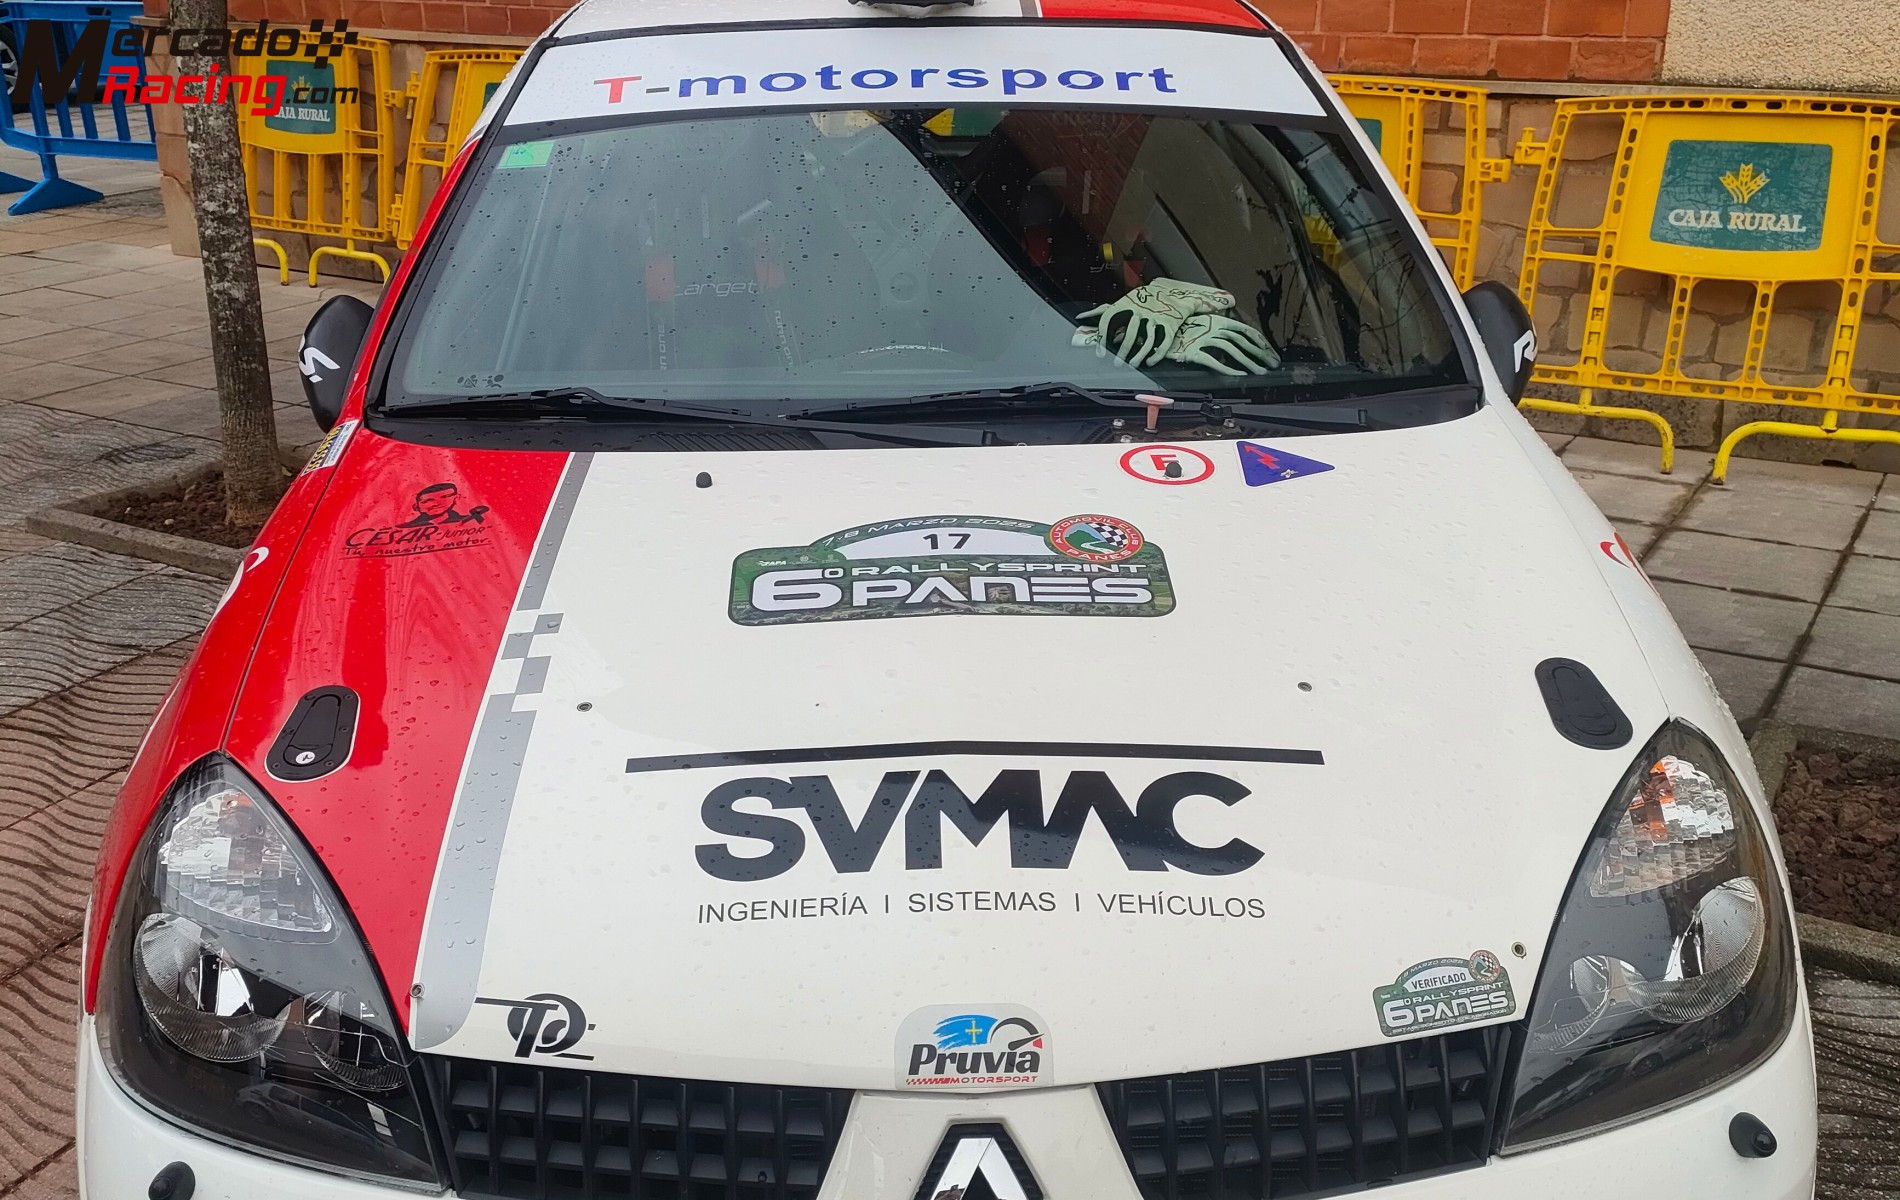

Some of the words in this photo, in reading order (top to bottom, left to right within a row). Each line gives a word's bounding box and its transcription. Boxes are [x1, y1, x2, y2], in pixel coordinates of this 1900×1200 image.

[593, 64, 1178, 104] T-motorsport
[275, 106, 297, 119] AJA
[298, 108, 331, 122] RURAL
[1668, 209, 1723, 229] CAJA
[1727, 211, 1807, 233] RURAL
[868, 518, 958, 534] MARZO
[1118, 523, 1140, 546] CLUB
[375, 544, 435, 555] nuestro
[922, 532, 972, 550] 17
[1066, 547, 1132, 561] PANES
[851, 562, 1147, 577] RALLYSPRINT
[852, 575, 1153, 607] PANES
[694, 768, 1266, 882] SVMAC
[698, 892, 868, 924] INGENIERÍA
[908, 891, 1057, 913] SISTEMAS
[1097, 888, 1266, 919] VEHÍCULOS
[1411, 972, 1467, 990] VERIFICADO
[1413, 981, 1504, 1004] RALLYSPRINT
[1415, 990, 1509, 1023] PANES
[949, 1076, 1038, 1084] MOTORSPORT
